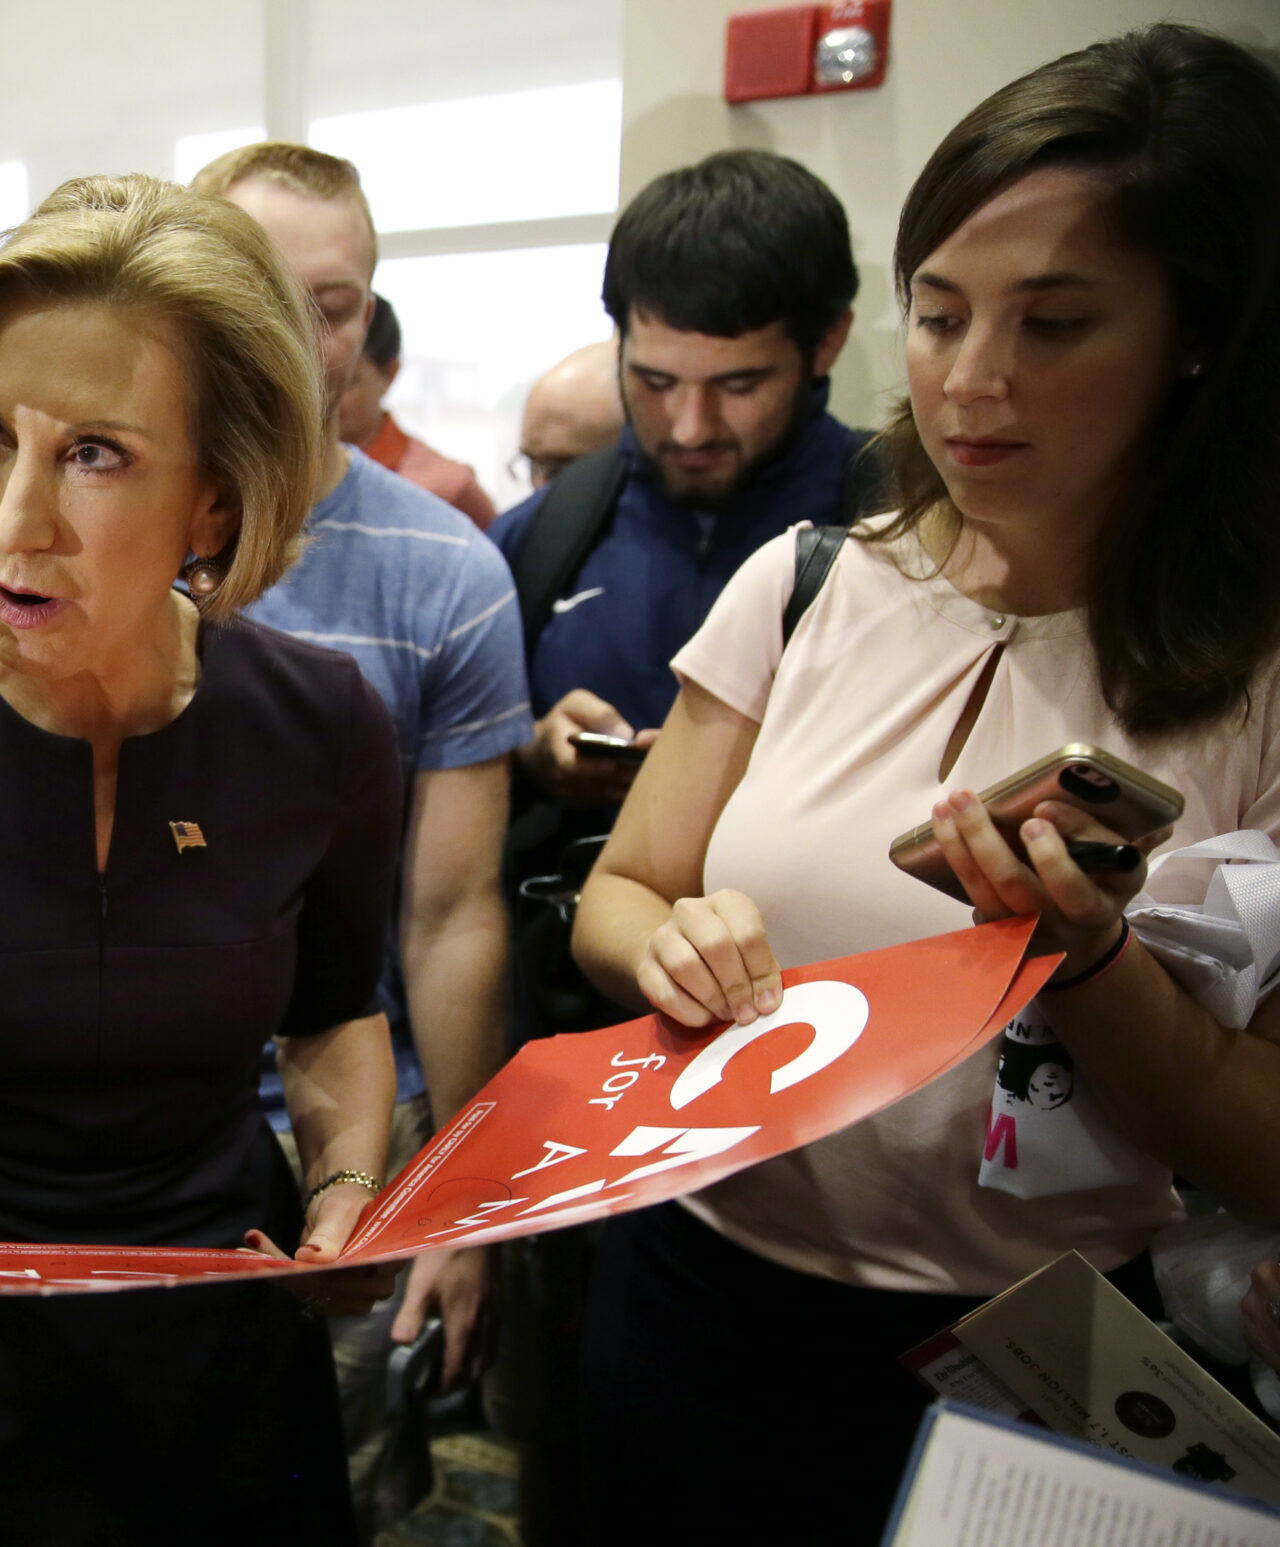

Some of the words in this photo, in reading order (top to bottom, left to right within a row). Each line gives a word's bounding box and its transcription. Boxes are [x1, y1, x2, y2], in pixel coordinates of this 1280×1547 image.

[588, 1050, 665, 1110] for
[1001, 1336, 1040, 1372] JOBS.
[1037, 1371, 1091, 1423] MILLION
[1087, 1420, 1110, 1438] 1.7
